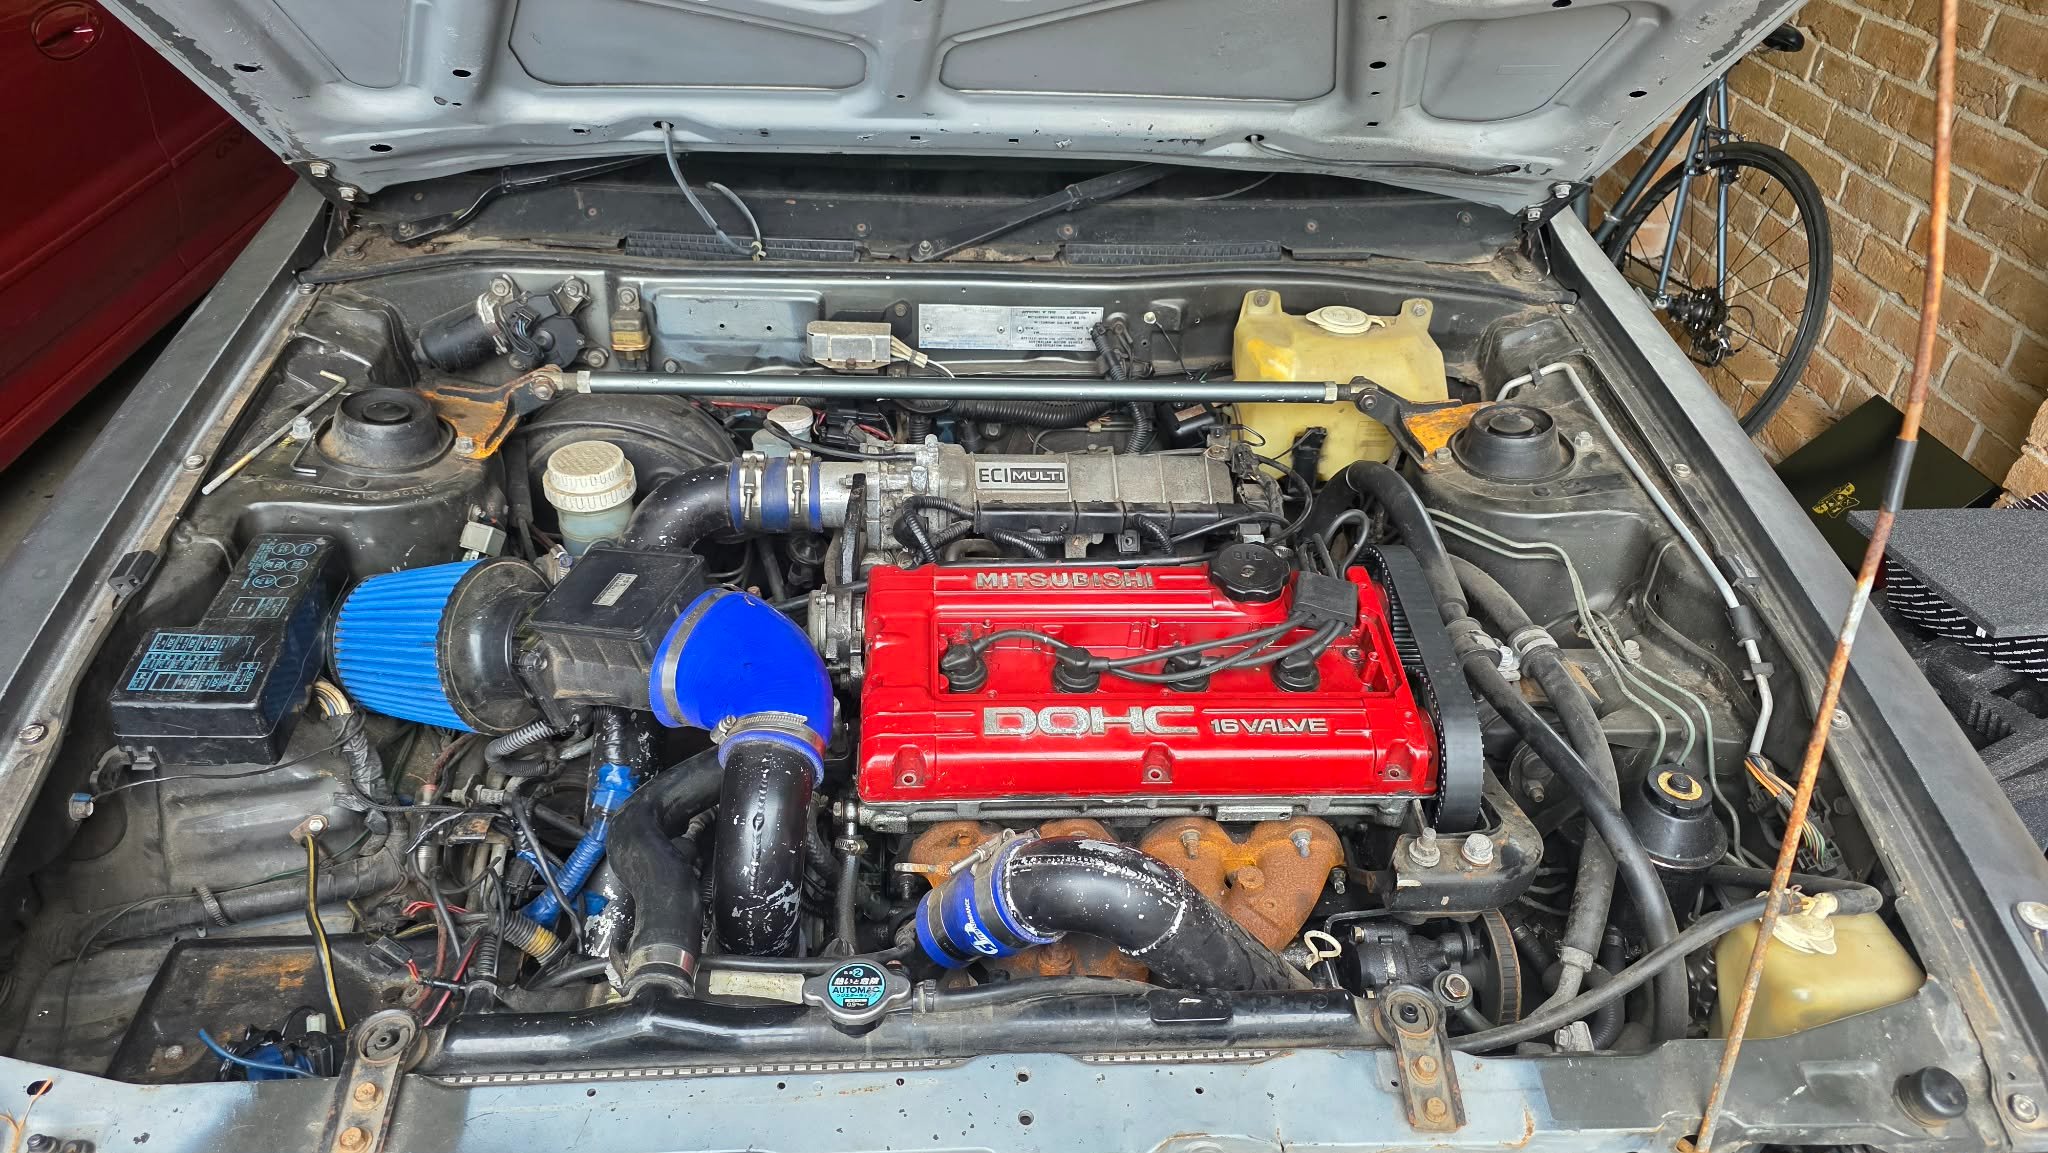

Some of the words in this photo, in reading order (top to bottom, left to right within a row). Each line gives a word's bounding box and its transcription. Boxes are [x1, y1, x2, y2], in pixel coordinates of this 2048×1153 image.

[979, 468, 1008, 482] ECI
[1012, 471, 1064, 481] MULTI
[1232, 551, 1263, 560] OIL
[976, 572, 1154, 589] MITSUBISHI
[983, 705, 1198, 736] DOHC
[832, 986, 881, 994] AUTOMAC
